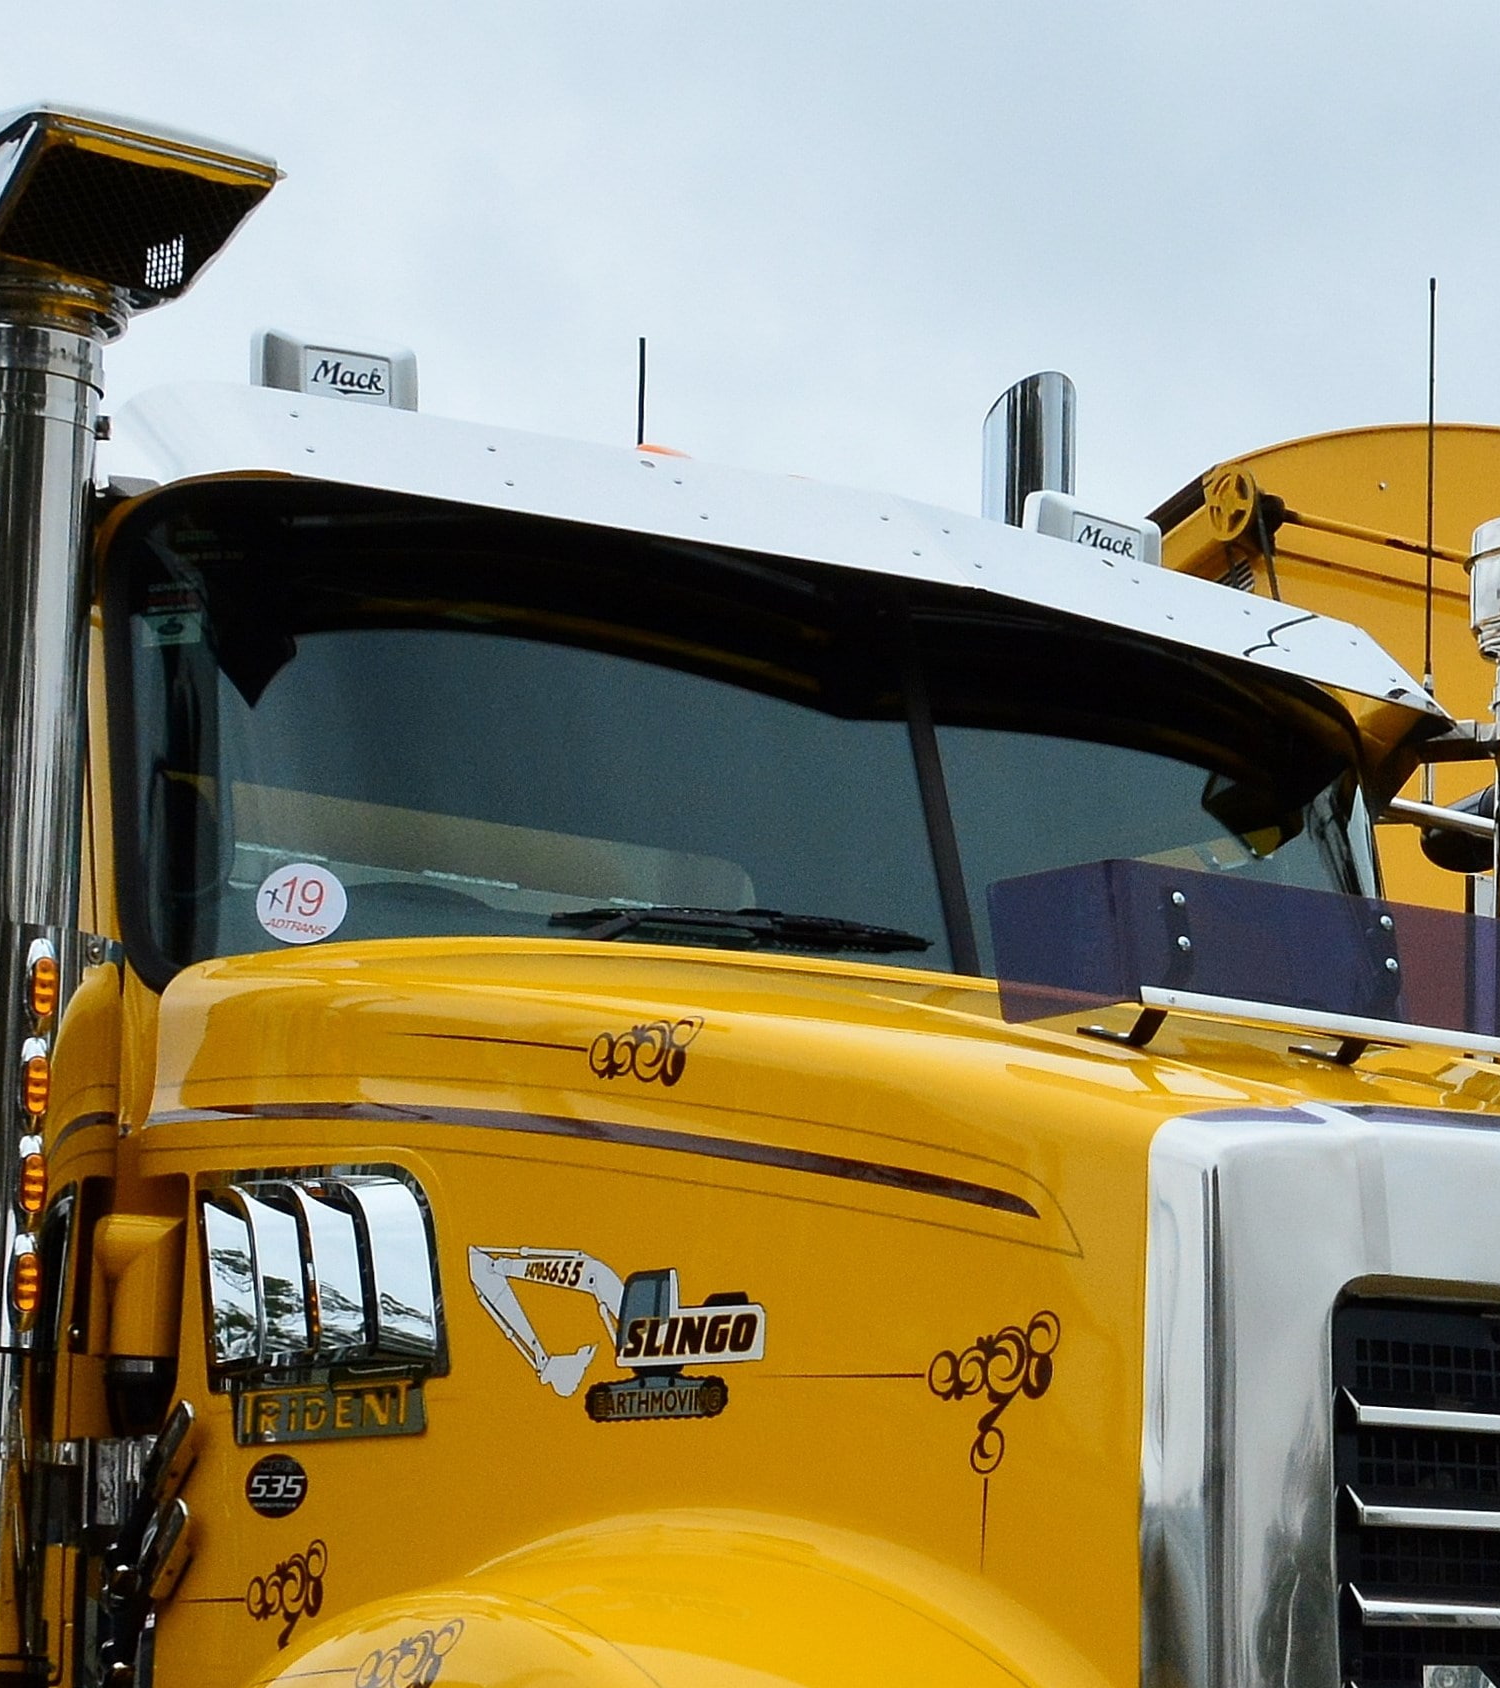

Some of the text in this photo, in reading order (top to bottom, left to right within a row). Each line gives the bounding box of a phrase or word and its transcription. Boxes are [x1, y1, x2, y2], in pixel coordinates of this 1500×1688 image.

[311, 360, 385, 395] Mack
[1077, 525, 1135, 559] Mack
[264, 918, 327, 936] ADTRANS
[623, 1313, 758, 1358] SLINGO
[593, 1386, 722, 1418] EARTHMOVING
[249, 1475, 306, 1498] 535
